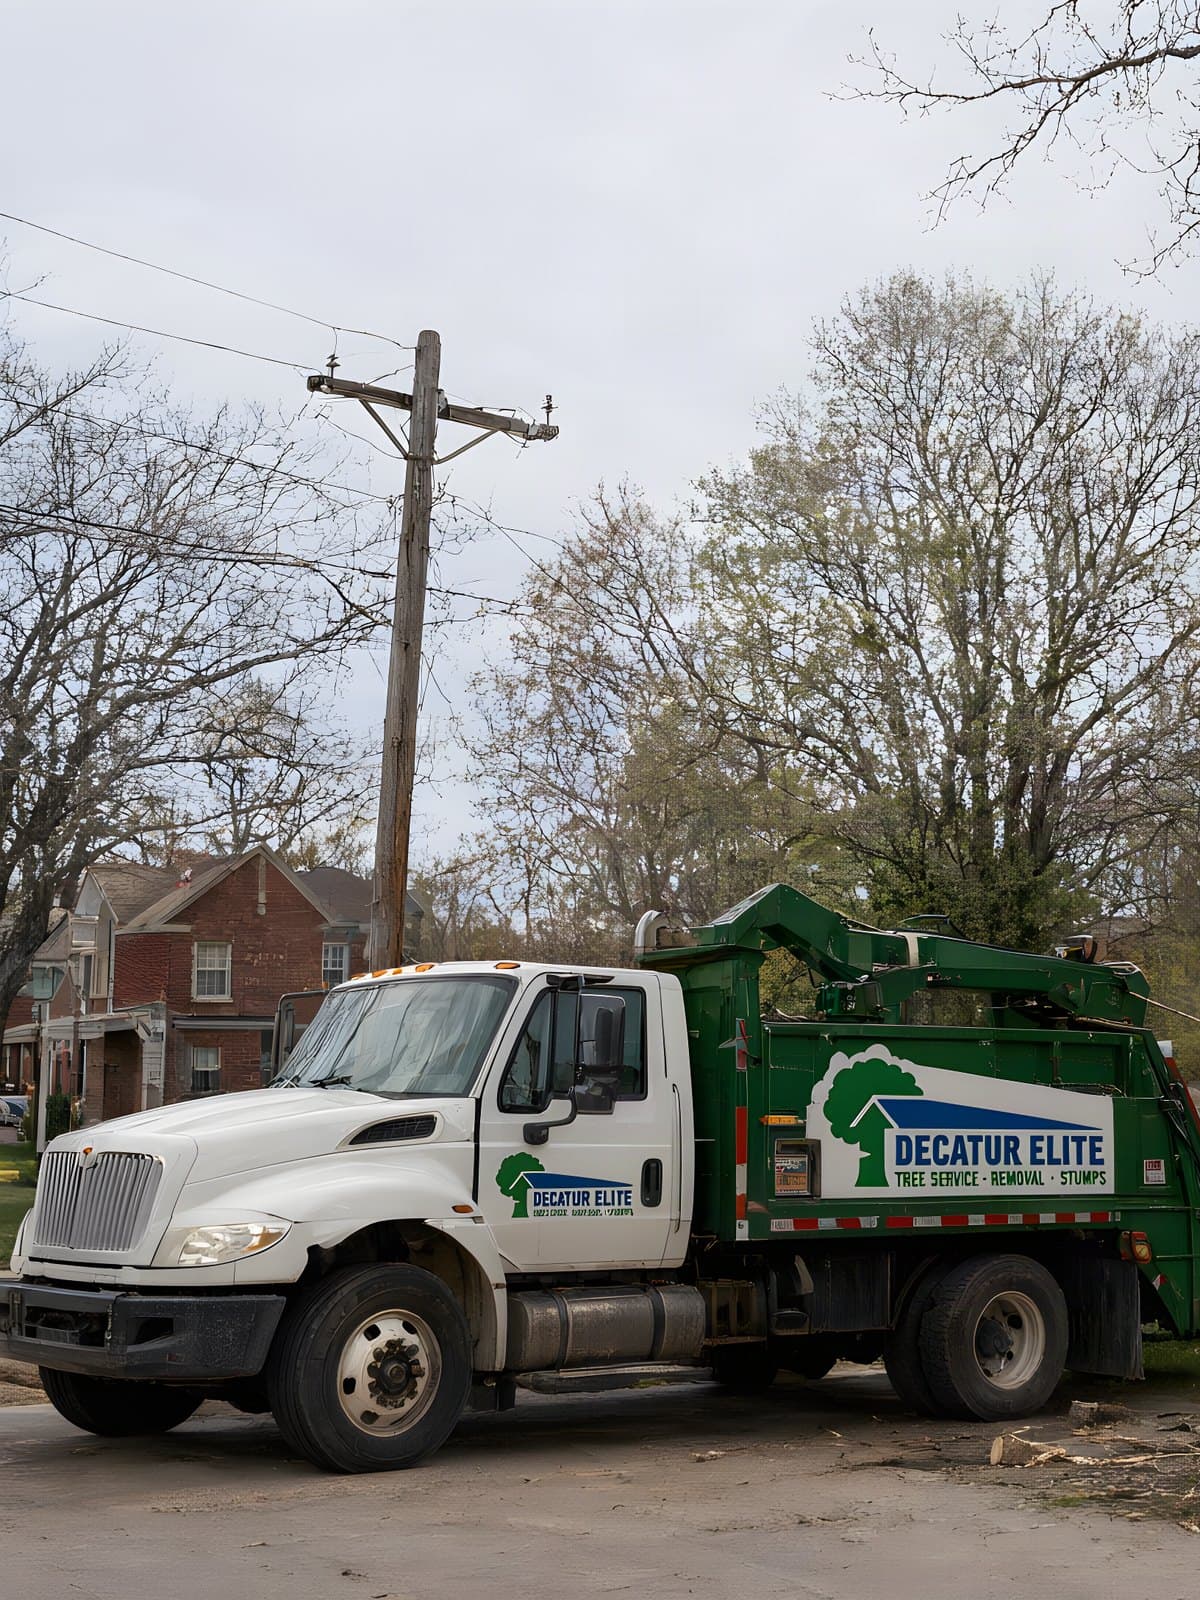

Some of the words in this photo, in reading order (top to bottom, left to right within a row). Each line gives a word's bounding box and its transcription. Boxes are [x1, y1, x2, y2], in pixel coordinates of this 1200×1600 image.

[895, 1134, 1022, 1166] DECATUR
[1029, 1135, 1105, 1166] ELITE
[894, 1171, 926, 1187] TREE
[991, 1170, 1045, 1187] REMOVAL
[1060, 1170, 1107, 1186] STUMPS
[533, 1190, 590, 1207] DECATUR
[595, 1189, 633, 1206] ELITE
